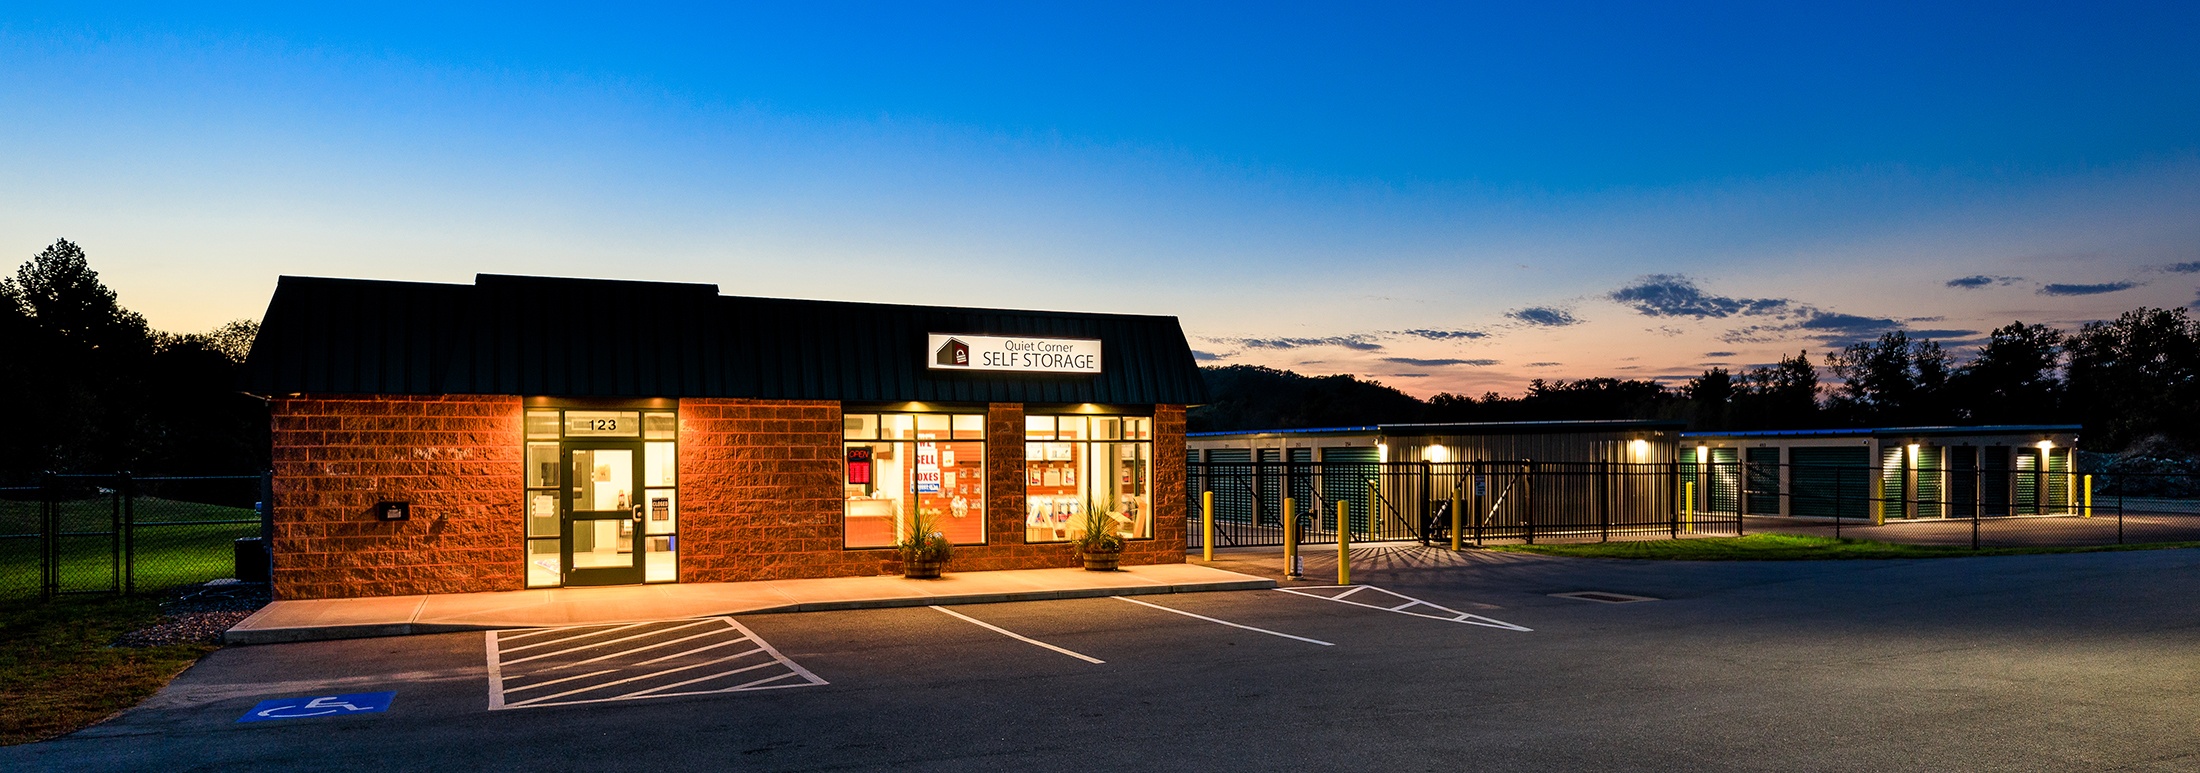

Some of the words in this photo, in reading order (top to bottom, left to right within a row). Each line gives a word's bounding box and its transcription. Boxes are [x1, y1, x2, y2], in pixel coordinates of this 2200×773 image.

[1005, 340, 1034, 351] Quiet
[1037, 341, 1073, 352] Corner
[983, 351, 1018, 366] SELF
[1023, 353, 1094, 368] STORAGE
[589, 419, 616, 431] 123
[849, 450, 868, 458] OPEN
